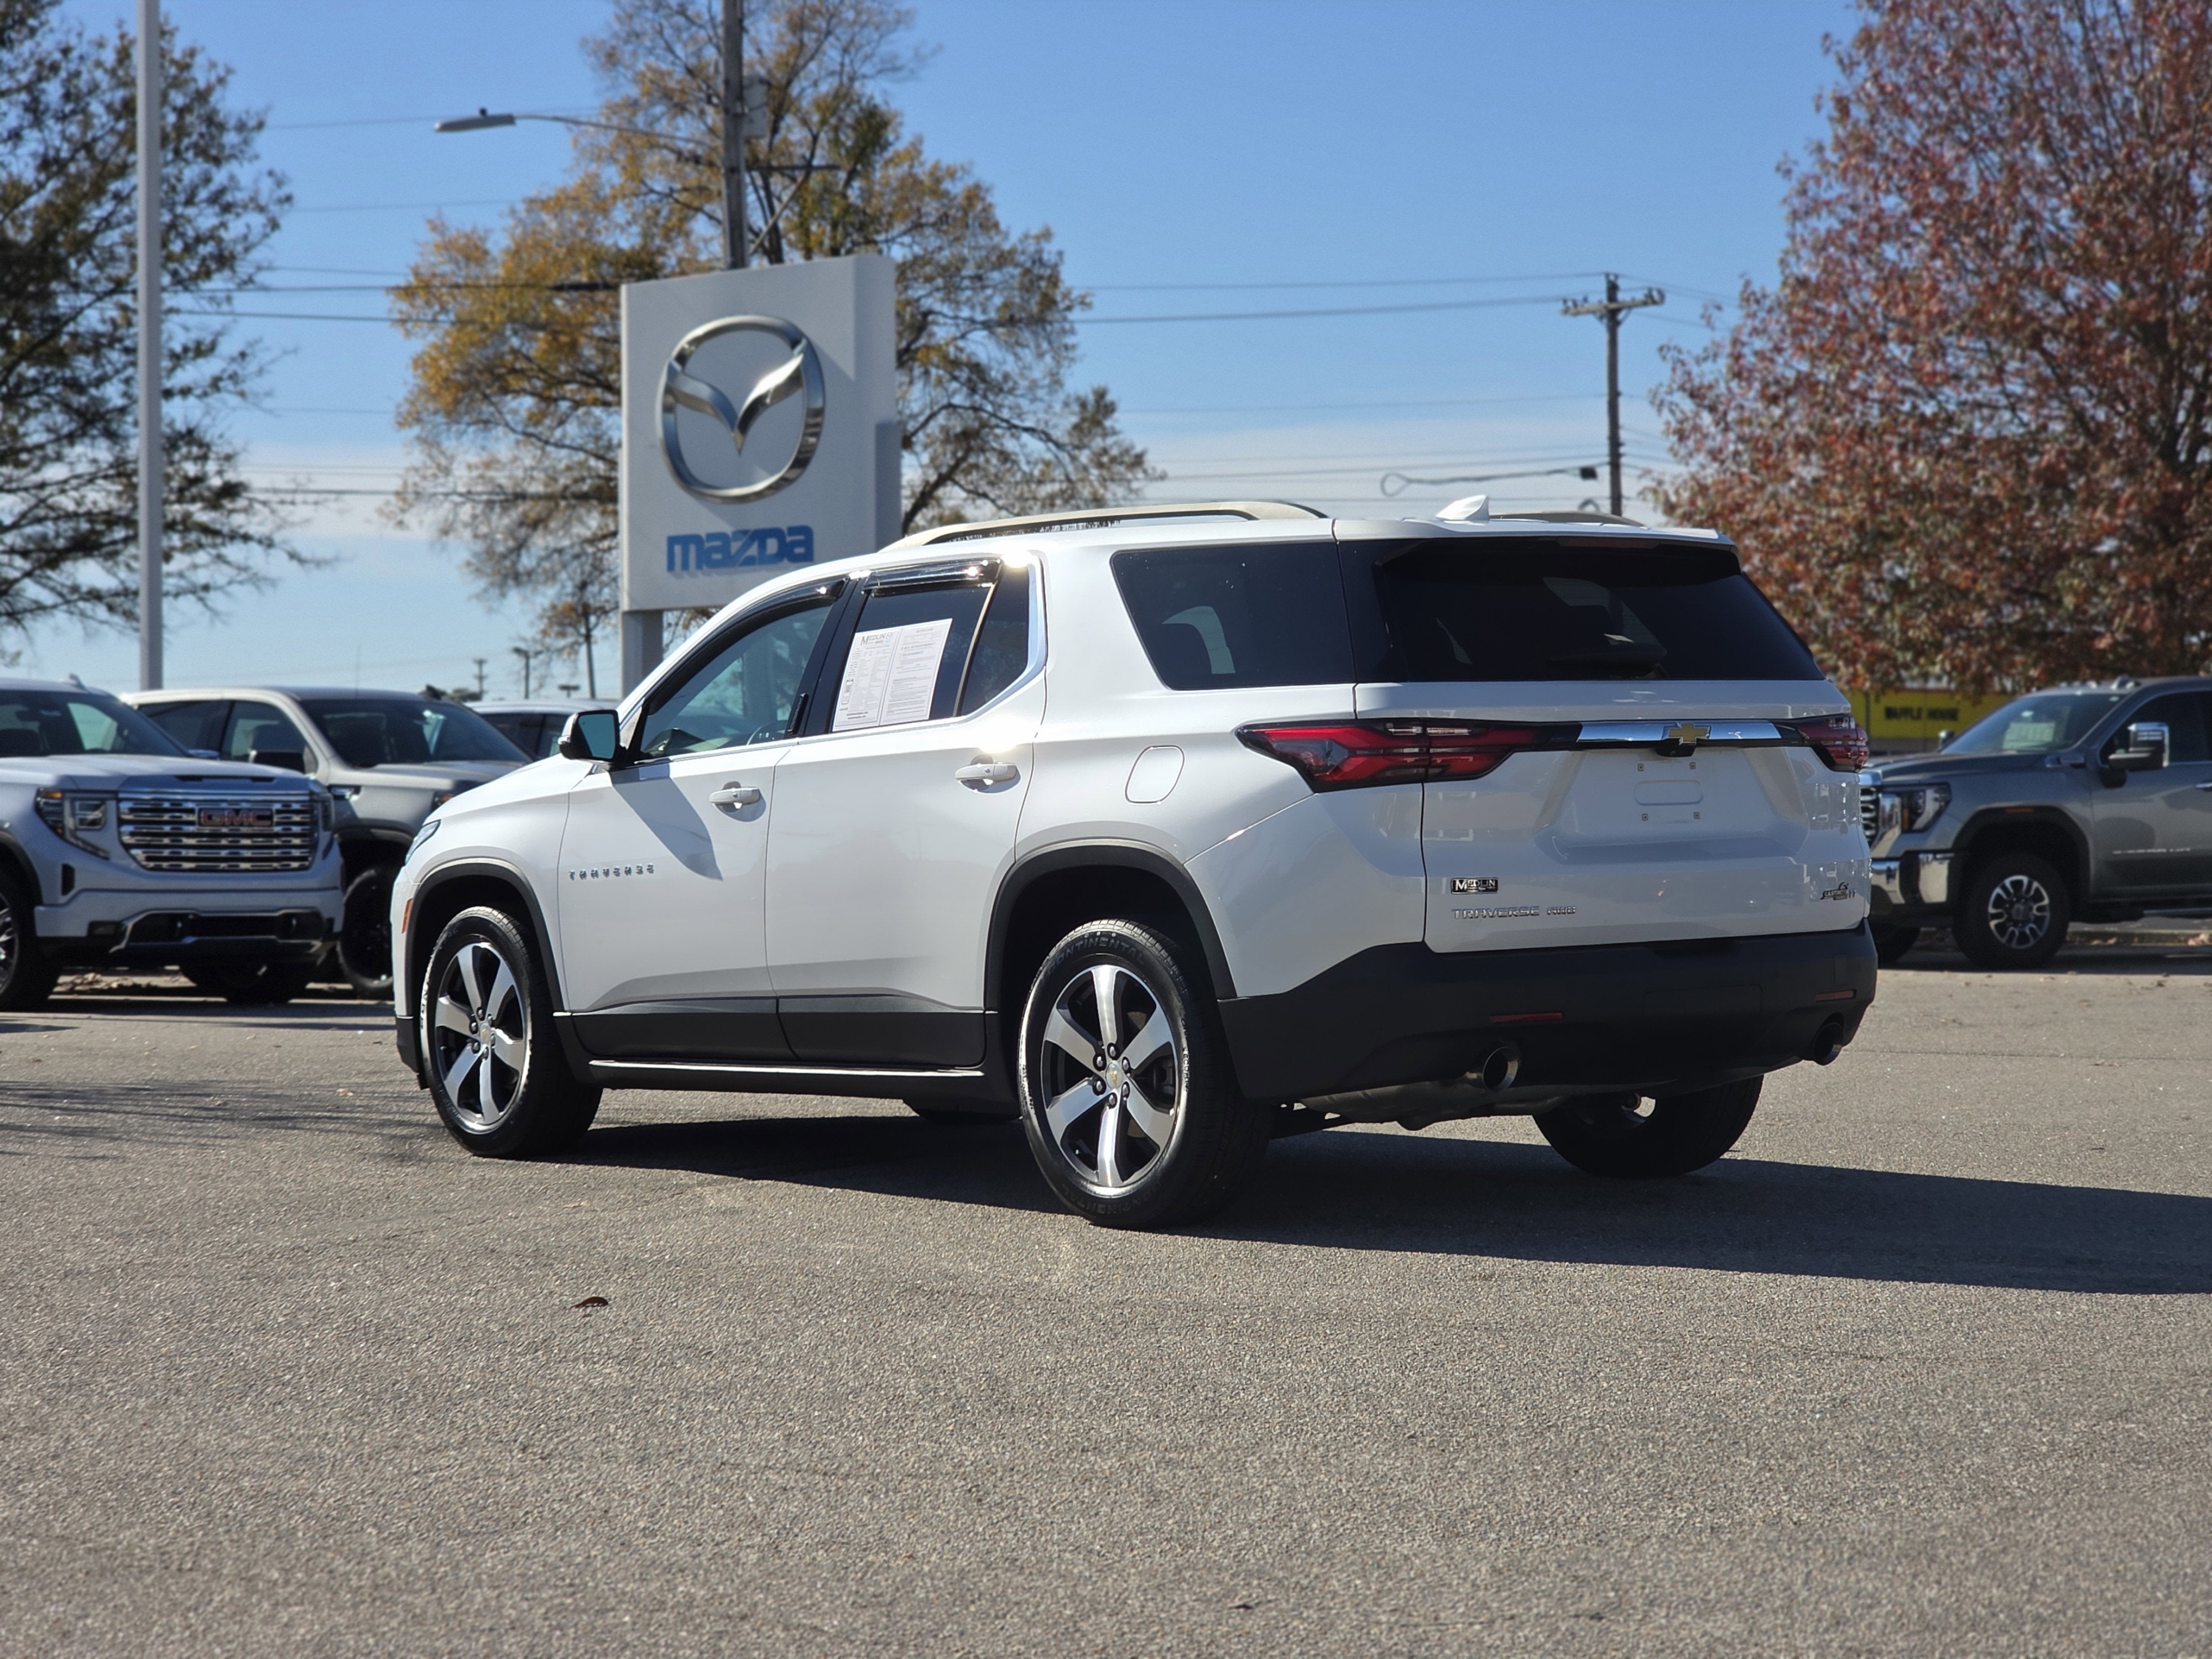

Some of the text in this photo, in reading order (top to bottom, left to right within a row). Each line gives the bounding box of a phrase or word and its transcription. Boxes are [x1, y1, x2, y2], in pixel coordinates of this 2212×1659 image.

[201, 809, 272, 826] GMC
[568, 863, 655, 881] TRAVERSE
[1455, 879, 1495, 891] MEDLIN
[1451, 905, 1577, 920] TRAVERSE AWD
[1047, 937, 1144, 973] CONTINENTAL
